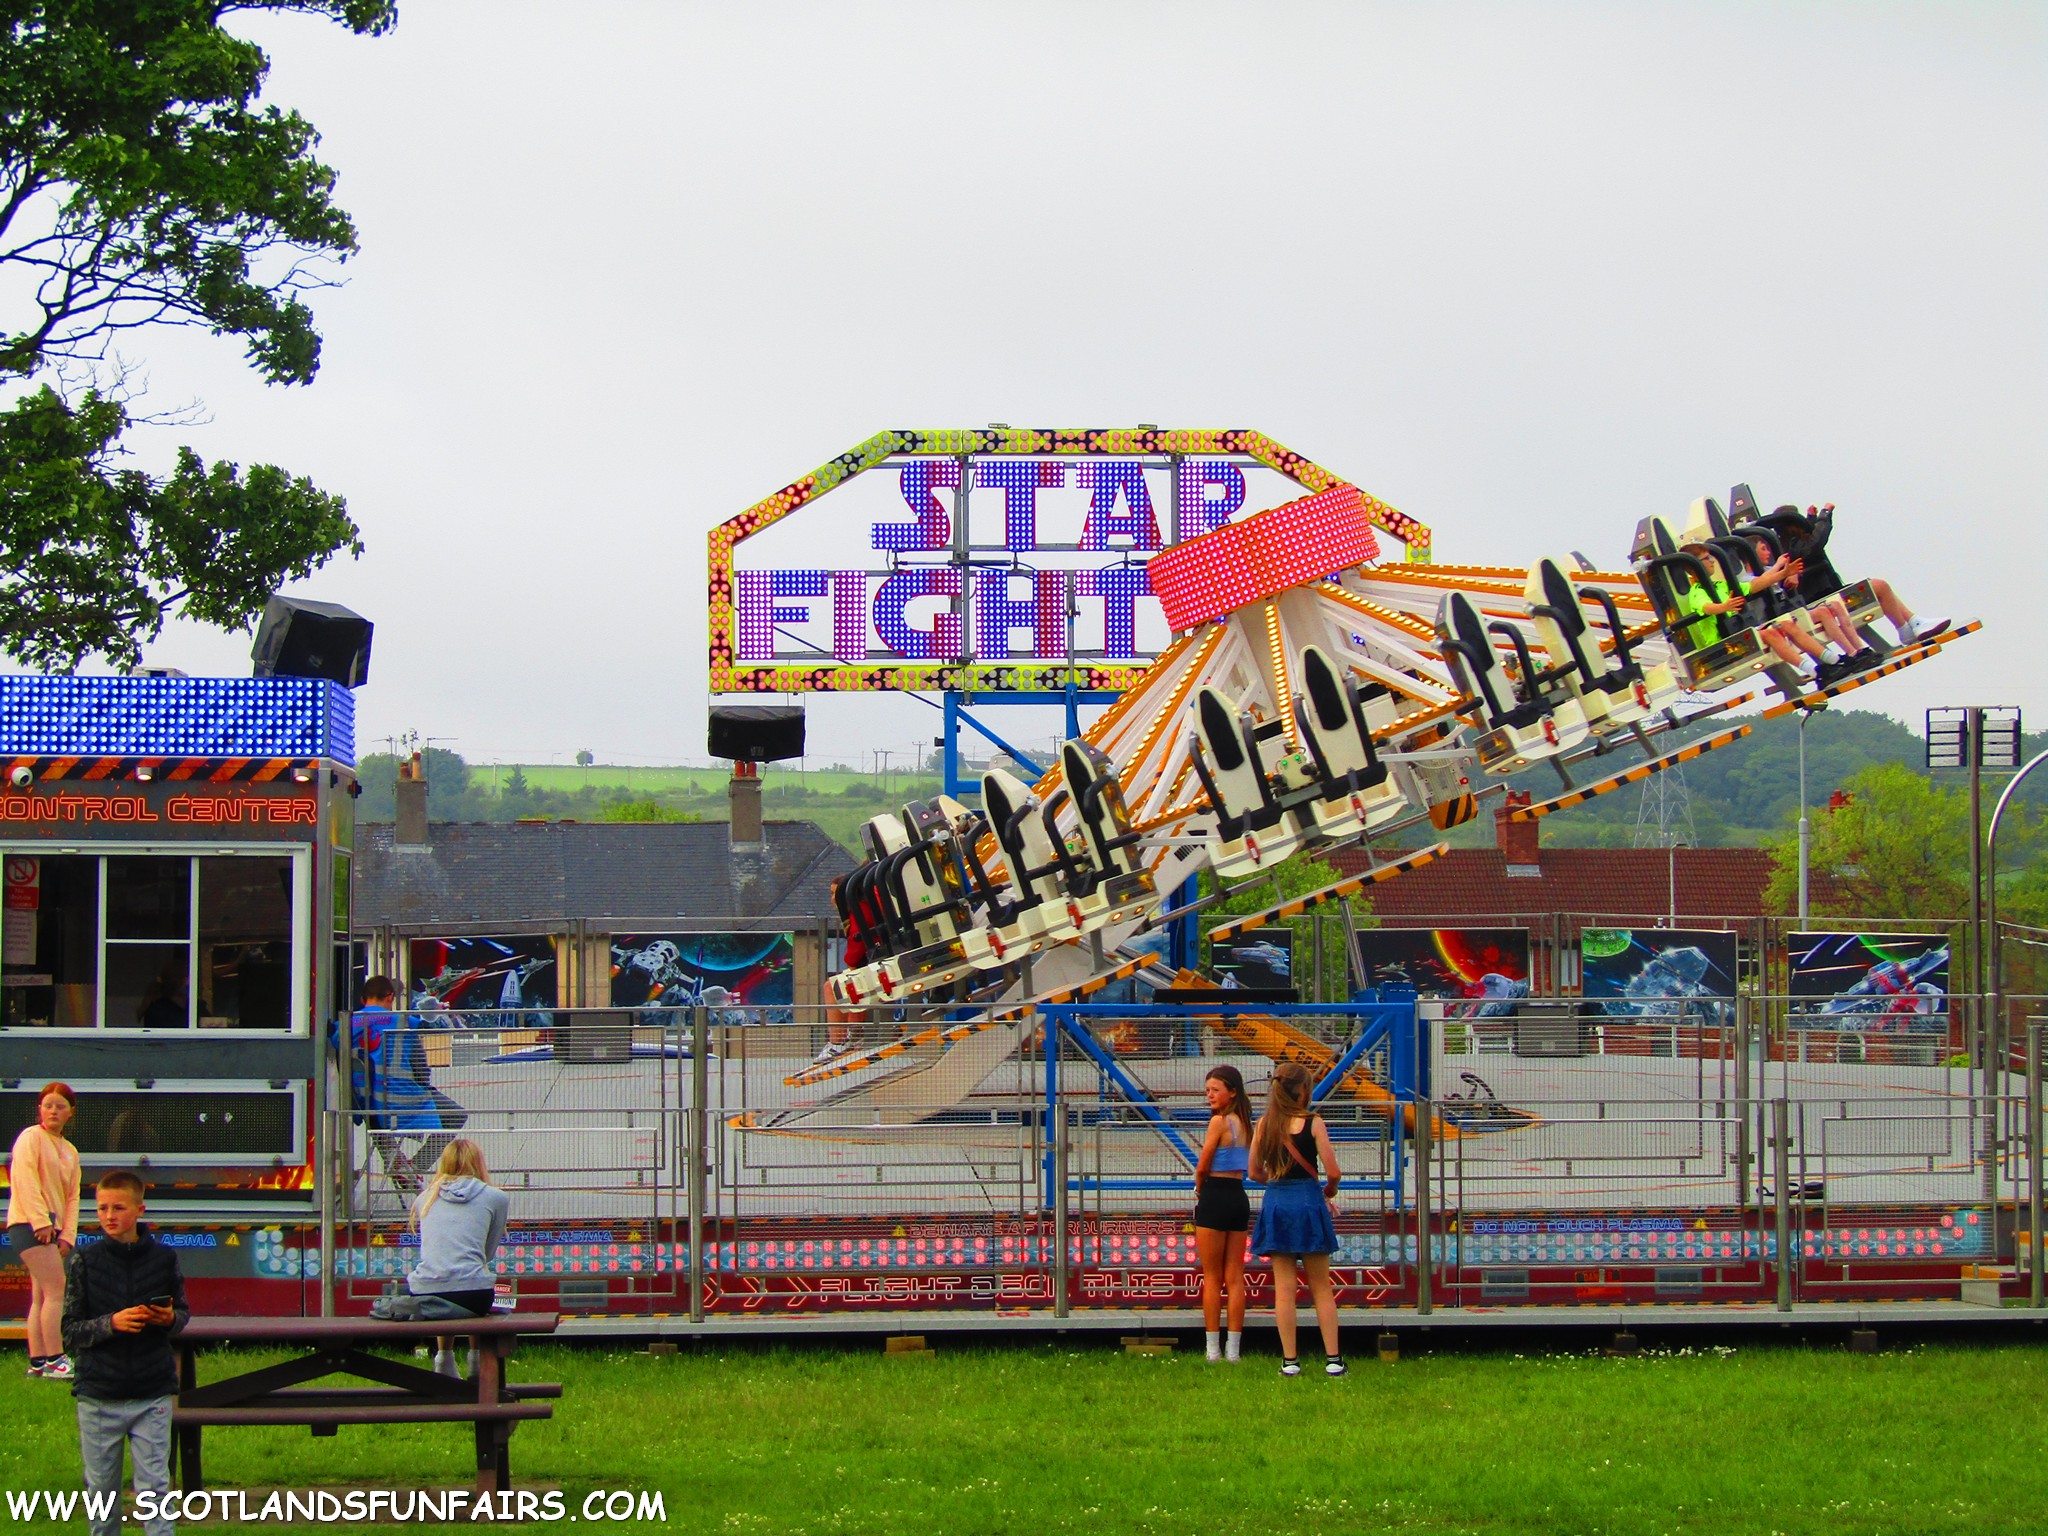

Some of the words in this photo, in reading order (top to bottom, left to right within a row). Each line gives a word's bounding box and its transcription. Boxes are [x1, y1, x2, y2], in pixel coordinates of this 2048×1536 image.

[871, 460, 1247, 551] STAR
[167, 798, 317, 822] CENTER
[909, 1222, 1003, 1238] BEWARE
[1473, 1221, 1499, 1233] DO
[1502, 1221, 1540, 1233] NOT
[1543, 1220, 1604, 1232] TOUCH
[1607, 1218, 1684, 1232] PLASMA
[150, 1233, 217, 1247] ASMA
[535, 1229, 613, 1243] PLASMA
[820, 1276, 962, 1303] FLIGHT
[1083, 1273, 1175, 1298] THIS
[1185, 1273, 1267, 1297] WY
